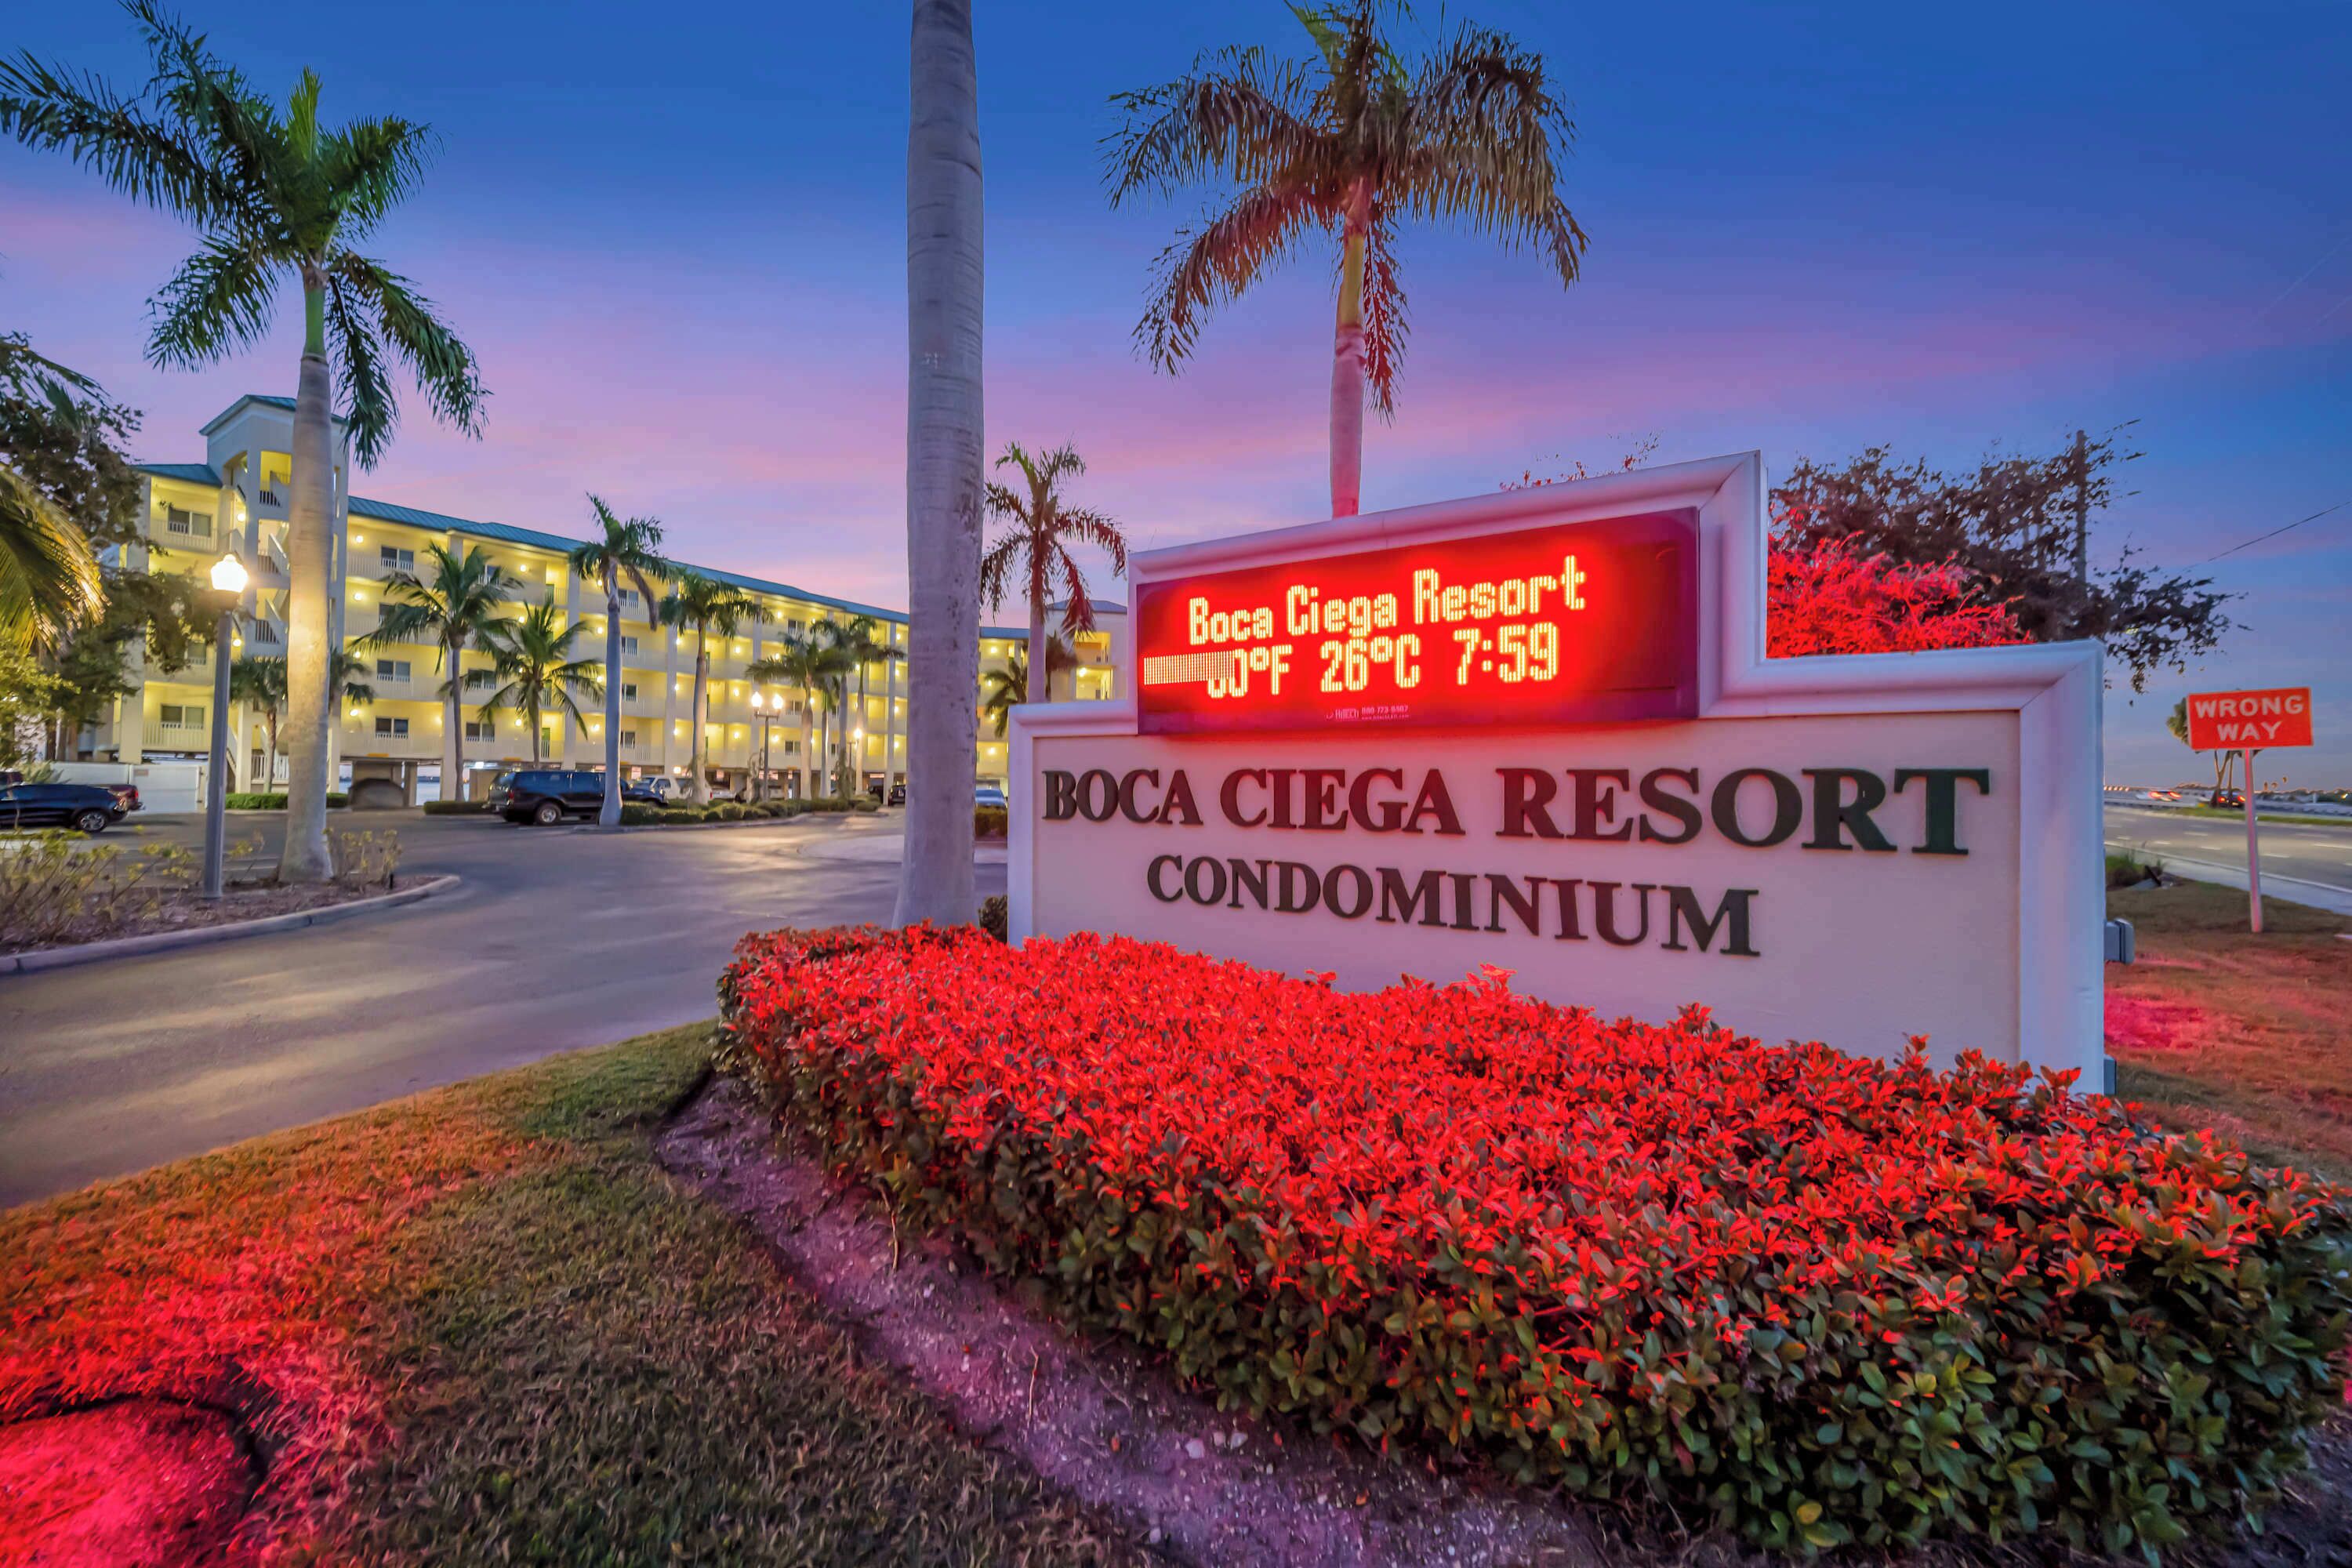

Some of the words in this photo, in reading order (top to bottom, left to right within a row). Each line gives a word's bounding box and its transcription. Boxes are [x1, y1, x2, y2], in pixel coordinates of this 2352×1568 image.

[1189, 597, 1274, 645] Boca
[1286, 584, 1398, 637] Ciega
[1412, 554, 1586, 625] Resort
[1453, 622, 1560, 686] 7:59
[2195, 695, 2303, 718] WRONG
[2217, 720, 2282, 741] WAY
[1041, 769, 1203, 826] BOCA
[1219, 768, 1466, 836] CIEGA
[1495, 768, 1990, 855] RESORT
[1147, 855, 1761, 957] CONDOMINIUM
